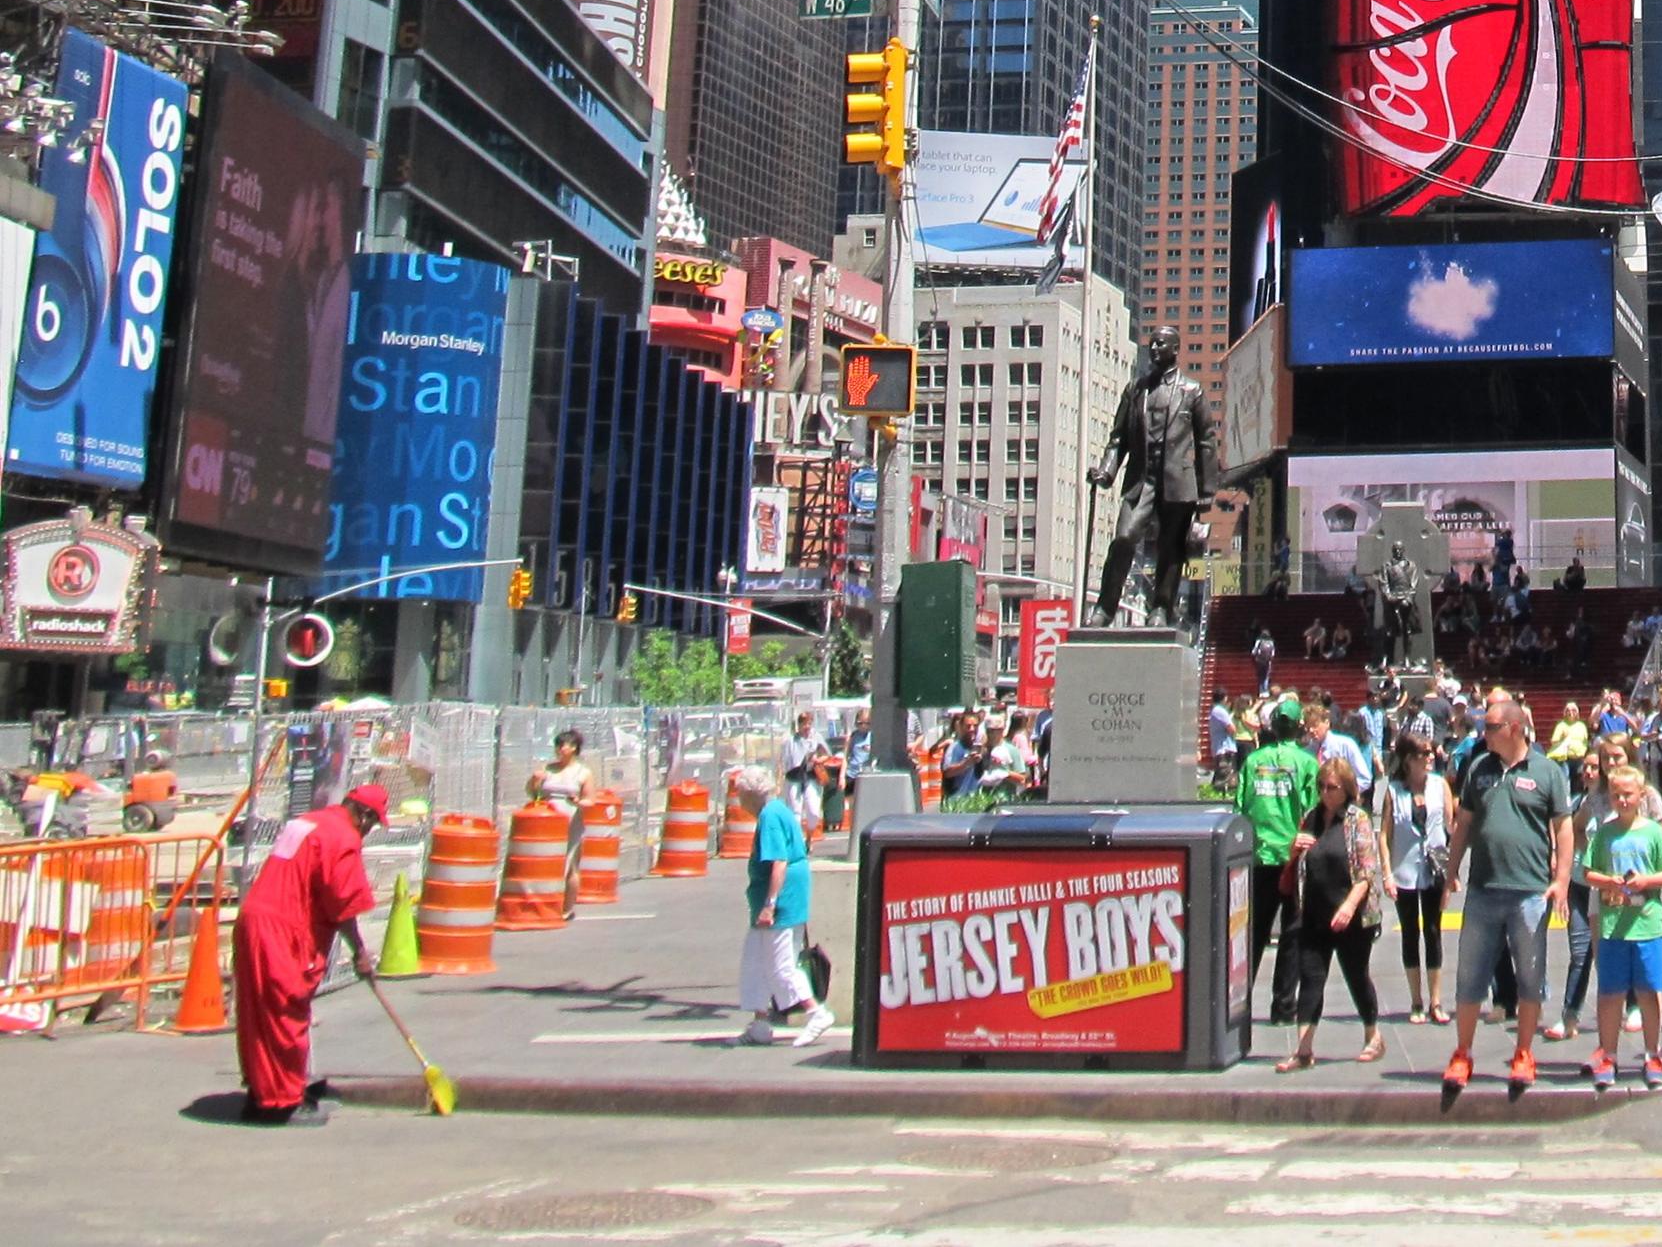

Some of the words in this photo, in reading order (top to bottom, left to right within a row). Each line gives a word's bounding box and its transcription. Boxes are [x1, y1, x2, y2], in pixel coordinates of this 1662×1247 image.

[922, 152, 951, 163] tablet
[953, 153, 976, 163] that
[978, 154, 992, 163] can
[937, 164, 962, 175] your
[219, 155, 264, 213] Faith
[949, 194, 967, 204] Pro
[969, 194, 975, 204] 3
[229, 211, 265, 254] taking
[264, 229, 283, 259] the
[211, 238, 237, 274] first
[381, 330, 438, 350] Morgan
[438, 333, 485, 356] Stanley
[1349, 347, 1378, 356] SHARE
[1382, 347, 1398, 355] THE
[1401, 345, 1439, 355] PASSION
[1442, 345, 1454, 354] AT
[1457, 343, 1553, 354] BECAUSEFUTBOL.COM
[99, 439, 116, 453] FOR
[117, 441, 145, 459] SOUND
[88, 453, 106, 467] FOR
[107, 457, 144, 475] EMOTION
[54, 556, 86, 587] R
[32, 617, 106, 633] radioshack
[1033, 607, 1069, 680] tkts
[1089, 693, 1145, 706] GEORGE
[1091, 719, 1142, 731] COHAN
[886, 902, 908, 921] THE
[910, 896, 947, 919] STORY
[950, 893, 965, 913] OF
[967, 886, 1018, 911] FRANKIE
[1020, 881, 1051, 904] VALLI
[1055, 882, 1066, 900] &
[1067, 877, 1090, 896] THE
[1092, 872, 1124, 895] FOUR
[1126, 865, 1180, 890] SEASONS
[880, 906, 1050, 1010] JERSEY
[1063, 889, 1186, 982] BOYS
[1029, 988, 1057, 1007] "THE
[1058, 979, 1099, 1004] CROWD
[1101, 974, 1129, 997] GOES
[1130, 961, 1170, 990] WILD!"
